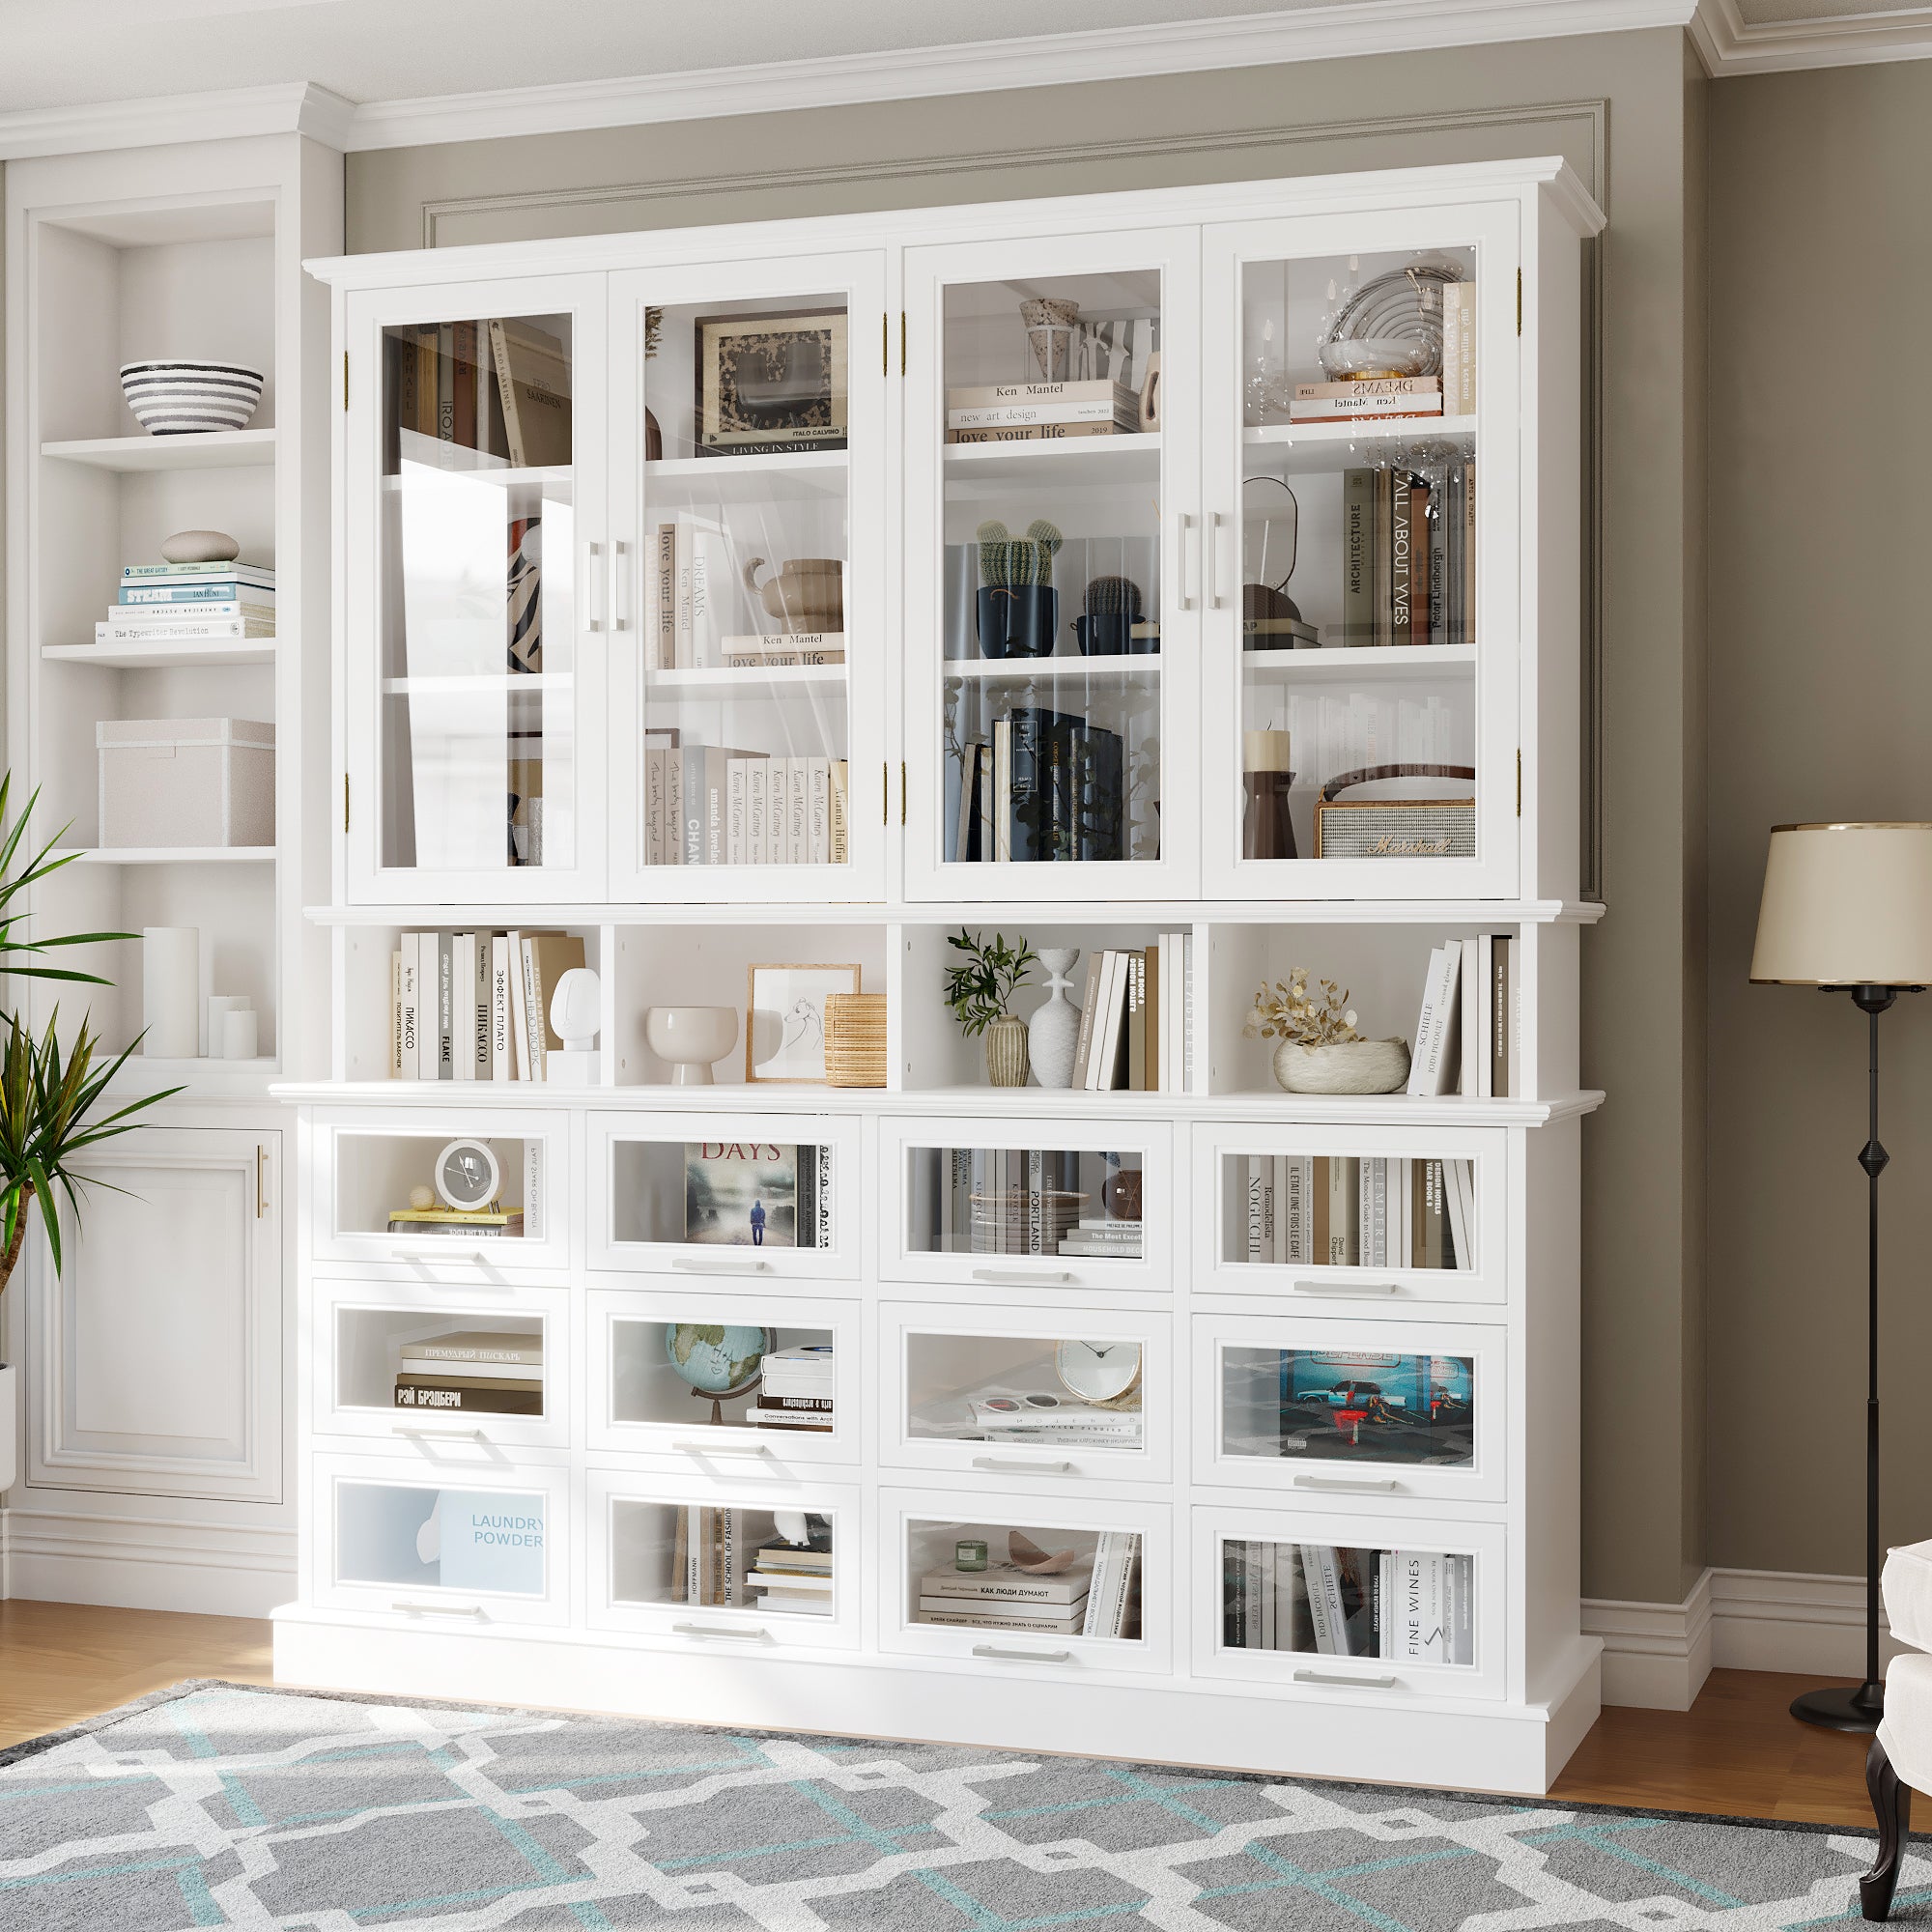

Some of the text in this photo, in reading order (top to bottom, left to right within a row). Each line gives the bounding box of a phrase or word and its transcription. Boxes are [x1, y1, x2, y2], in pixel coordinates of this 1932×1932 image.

[996, 384, 1064, 396] Ken Mantel
[960, 413, 980, 422] new
[986, 412, 1000, 421] art
[1007, 410, 1037, 422] design
[955, 430, 988, 443] love
[996, 428, 1033, 441] your
[1040, 424, 1065, 439] life
[732, 444, 769, 455] LIVING
[786, 442, 819, 452] STYLE
[1351, 504, 1361, 594] ARCHITECTURE
[1395, 478, 1408, 625] ALL ABOUT YVES
[659, 530, 674, 634] love your life
[694, 556, 705, 617] DREAMS
[681, 567, 691, 631] Ken Mantel
[128, 629, 168, 639] Typewriter
[169, 627, 209, 636] Revolution
[763, 634, 822, 644] Ken Mantel
[728, 655, 756, 668] love
[803, 652, 824, 666] life
[650, 760, 660, 781] The
[669, 760, 679, 781] The
[733, 771, 742, 793] Karen
[753, 771, 762, 793] Karen
[773, 770, 781, 792] Karen
[793, 770, 802, 792] Karen
[814, 769, 823, 792] Karen
[710, 788, 719, 823] amanda
[729, 796, 742, 838] McCartney
[750, 796, 762, 838] McCartney
[770, 795, 781, 838] McCartney
[790, 795, 802, 838] McCartney
[811, 795, 823, 838] McCartney
[835, 788, 844, 825] Arianna
[645, 810, 661, 842] beyond
[666, 810, 680, 842] beyond
[1366, 834, 1453, 854] Marshall
[497, 970, 505, 1051] ЭФФЕКТ ПЛАТО
[405, 1007, 414, 1049] ПИКАССО
[477, 1005, 488, 1063] ПИКАССО
[526, 1000, 540, 1065] НЬЮ-ЙОРК
[1419, 1003, 1434, 1046] SCHIELE
[1432, 1020, 1443, 1054] PICOULT
[441, 1036, 450, 1063] FLAKE
[701, 1143, 781, 1161] DAYS
[1249, 1177, 1261, 1254] NOGUCHI
[1264, 1186, 1272, 1238] Remodelista
[1290, 1197, 1300, 1210] UNE
[1031, 1190, 1040, 1252] PORTLAND
[1290, 1211, 1300, 1229] FOIS
[1290, 1230, 1300, 1239] LE
[397, 1386, 462, 1407] РЭЙ БРЭДБЕРИ
[471, 1514, 544, 1530] LAUNDRY
[474, 1531, 544, 1548] POWDER
[724, 1541, 732, 1553] OF
[980, 1586, 1049, 1599] КАК ЛЮДИ ДУМАЮТ
[1408, 1559, 1419, 1656] FINE WINES
